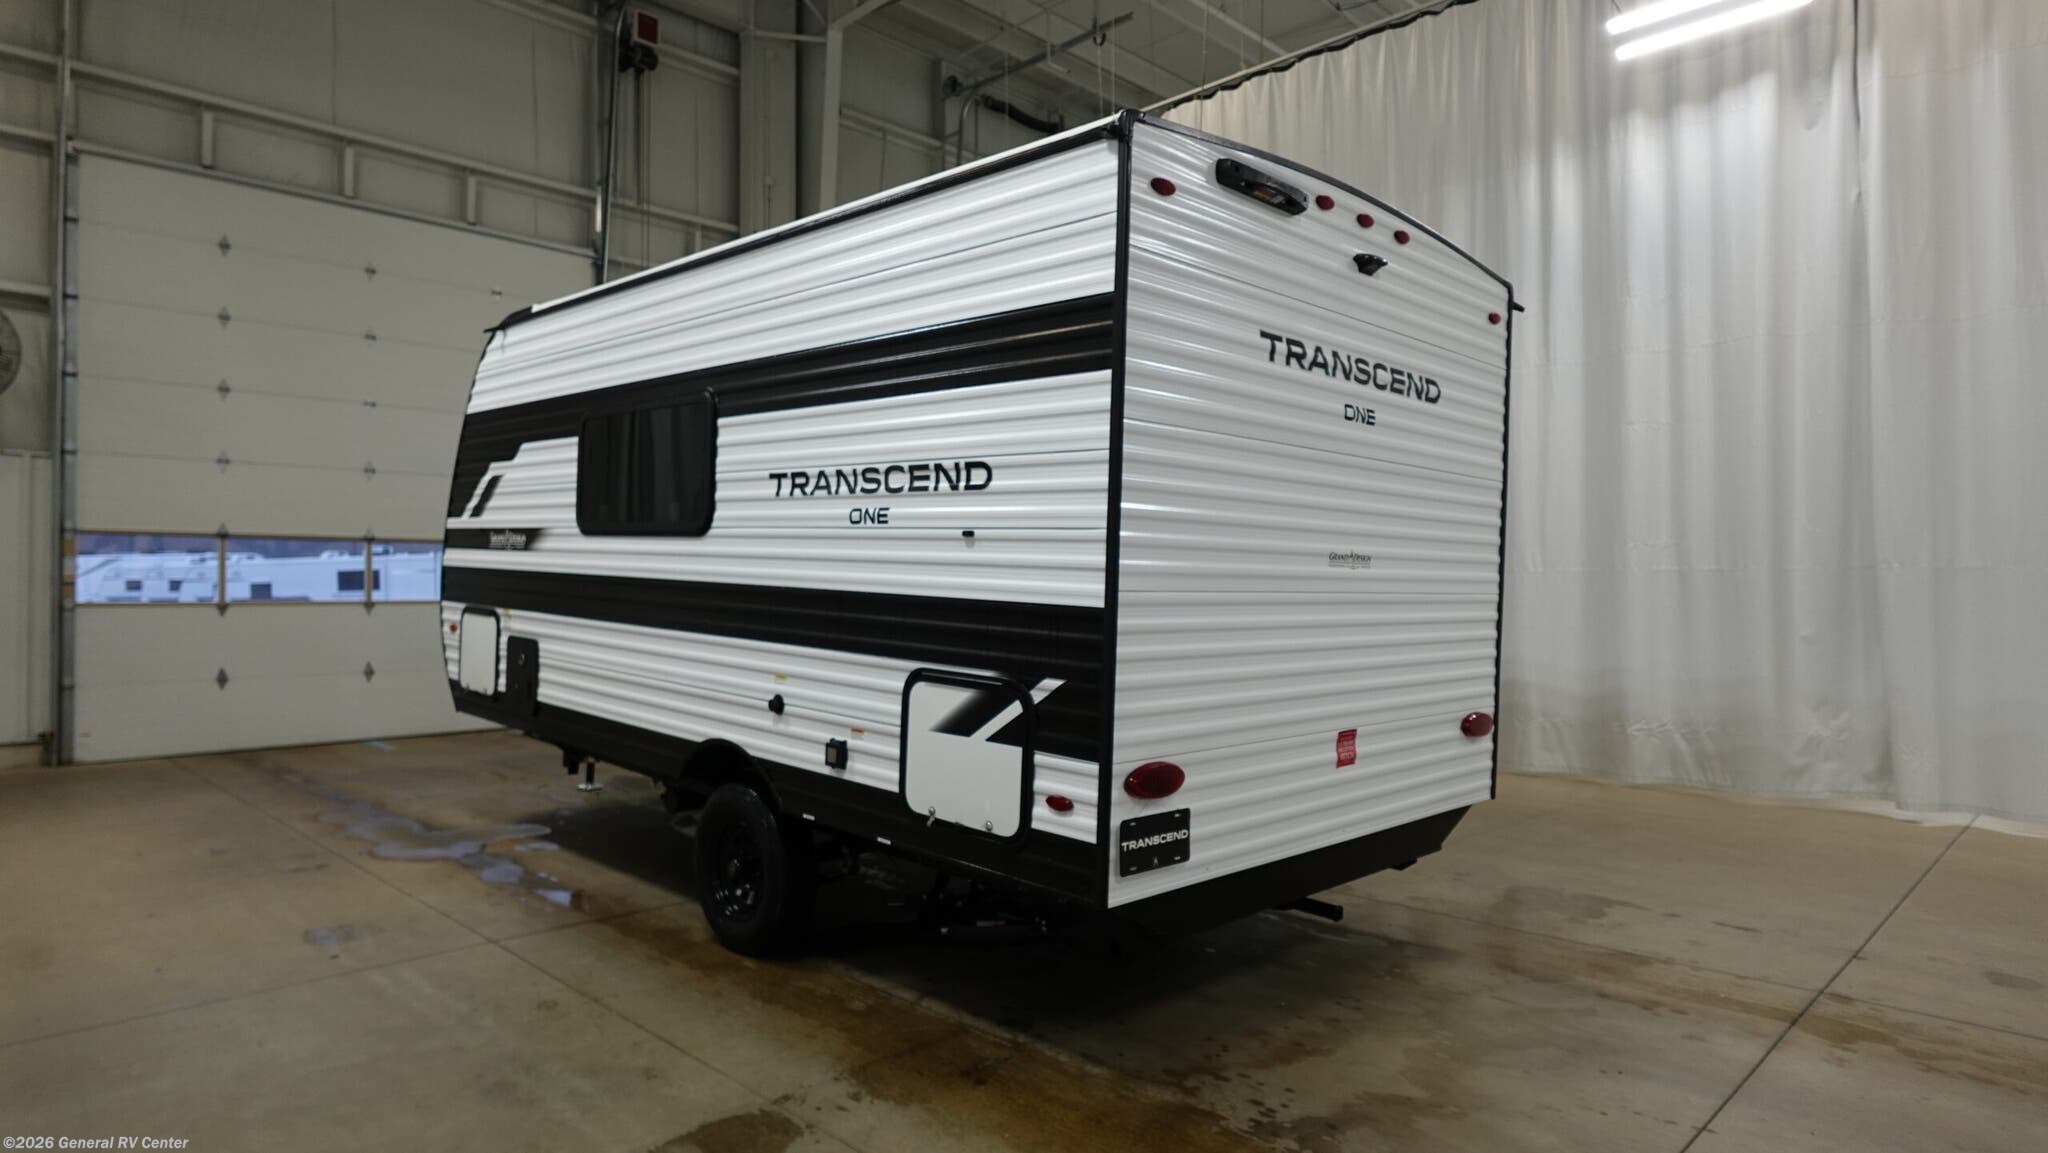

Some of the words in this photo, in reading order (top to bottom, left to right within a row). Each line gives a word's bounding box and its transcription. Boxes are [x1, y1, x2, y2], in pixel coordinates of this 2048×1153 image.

[1259, 329, 1442, 404] TRANSCEND
[1344, 403, 1377, 426] ONE
[769, 460, 993, 498] TRANSCEND
[849, 507, 890, 525] ONE
[1121, 829, 1189, 852] TRANSCEND
